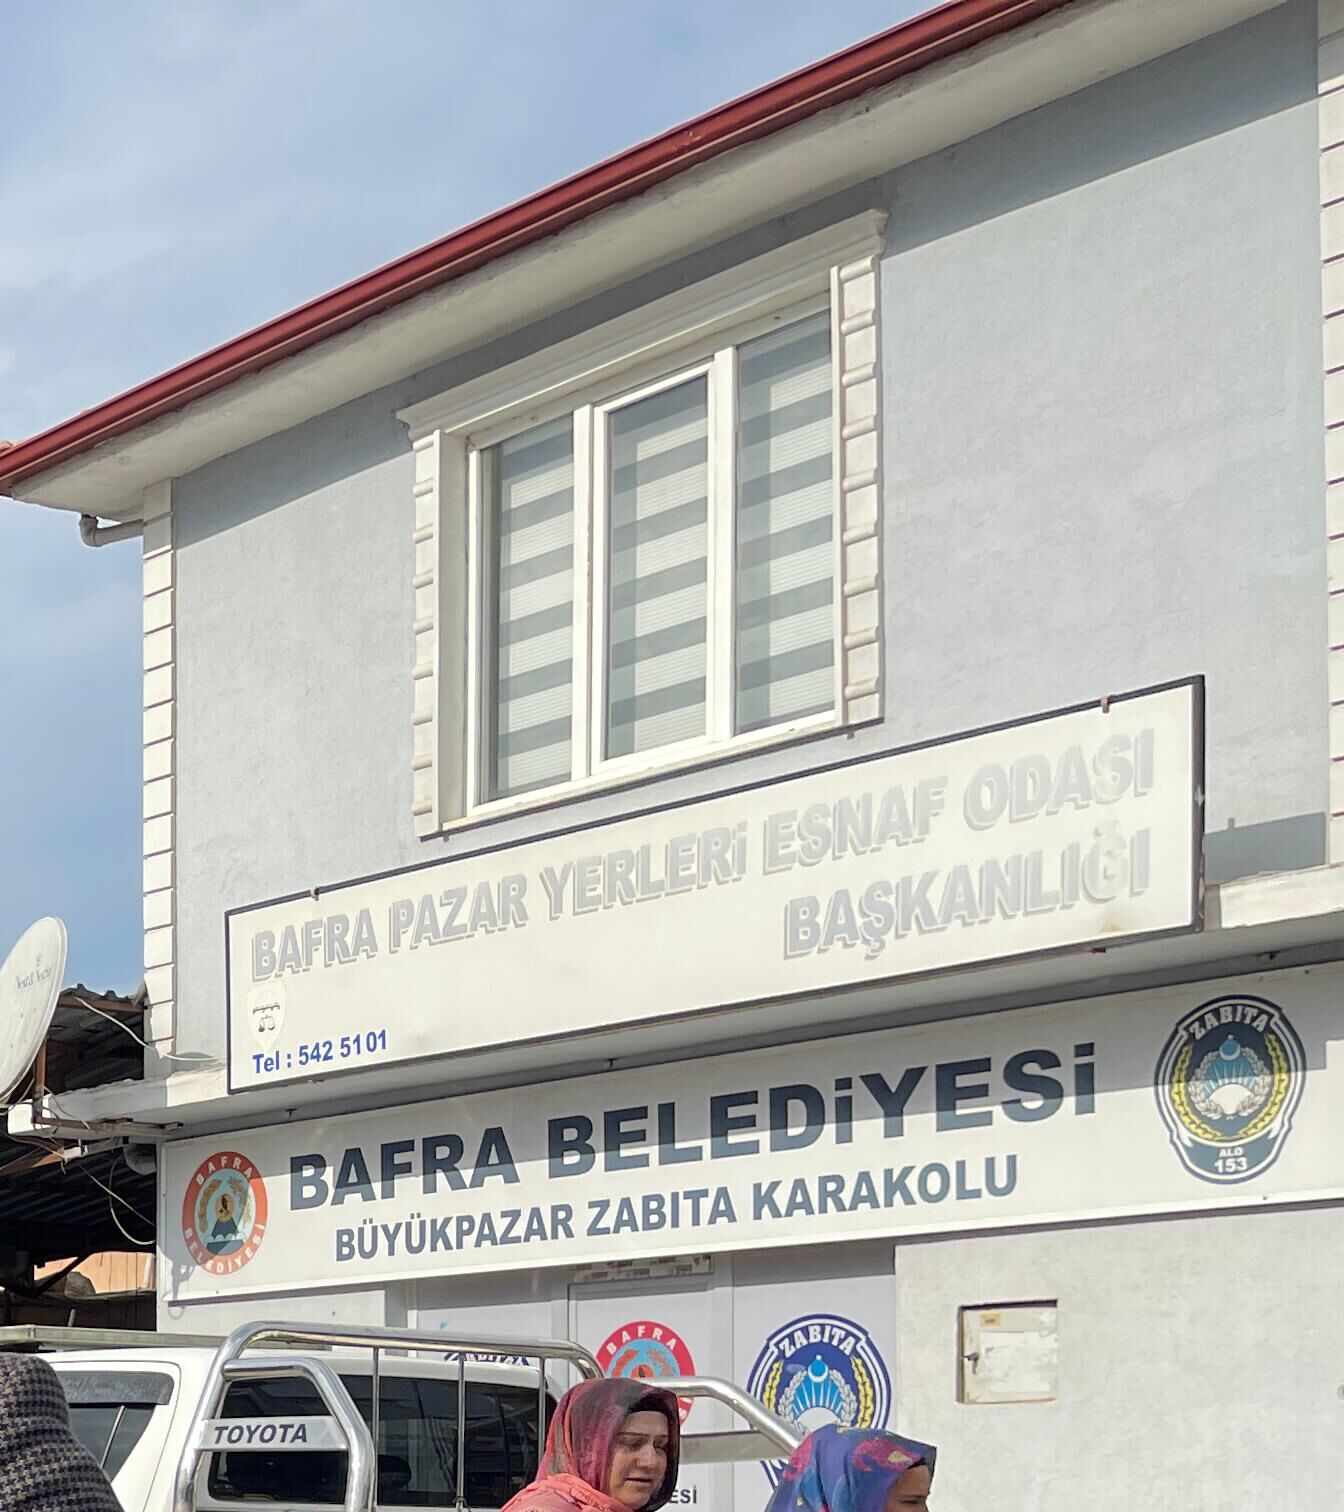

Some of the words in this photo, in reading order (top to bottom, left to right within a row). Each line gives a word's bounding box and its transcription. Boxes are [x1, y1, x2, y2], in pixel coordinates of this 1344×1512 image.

[251, 908, 379, 982] BAFRA
[388, 874, 530, 953] PAZAR
[761, 775, 949, 876] ESNAF
[963, 728, 1155, 831] ODASI
[783, 818, 1153, 960] BAŞKANLIĞI
[1188, 1004, 1272, 1040] ZABITA
[252, 1050, 280, 1074] Tel
[298, 1040, 334, 1066] 542
[195, 1155, 254, 1186] BAFRA
[289, 1126, 521, 1211] BAFRA
[1214, 1156, 1248, 1173] 153
[335, 1202, 575, 1263] BÜYÜKPAZAR
[586, 1186, 738, 1236] ZABITA
[752, 1153, 1018, 1221] KARAKOLU
[605, 1325, 677, 1356] BAFRA
[778, 1324, 857, 1358] ZABITA
[214, 1423, 308, 1445] TOYOTA
